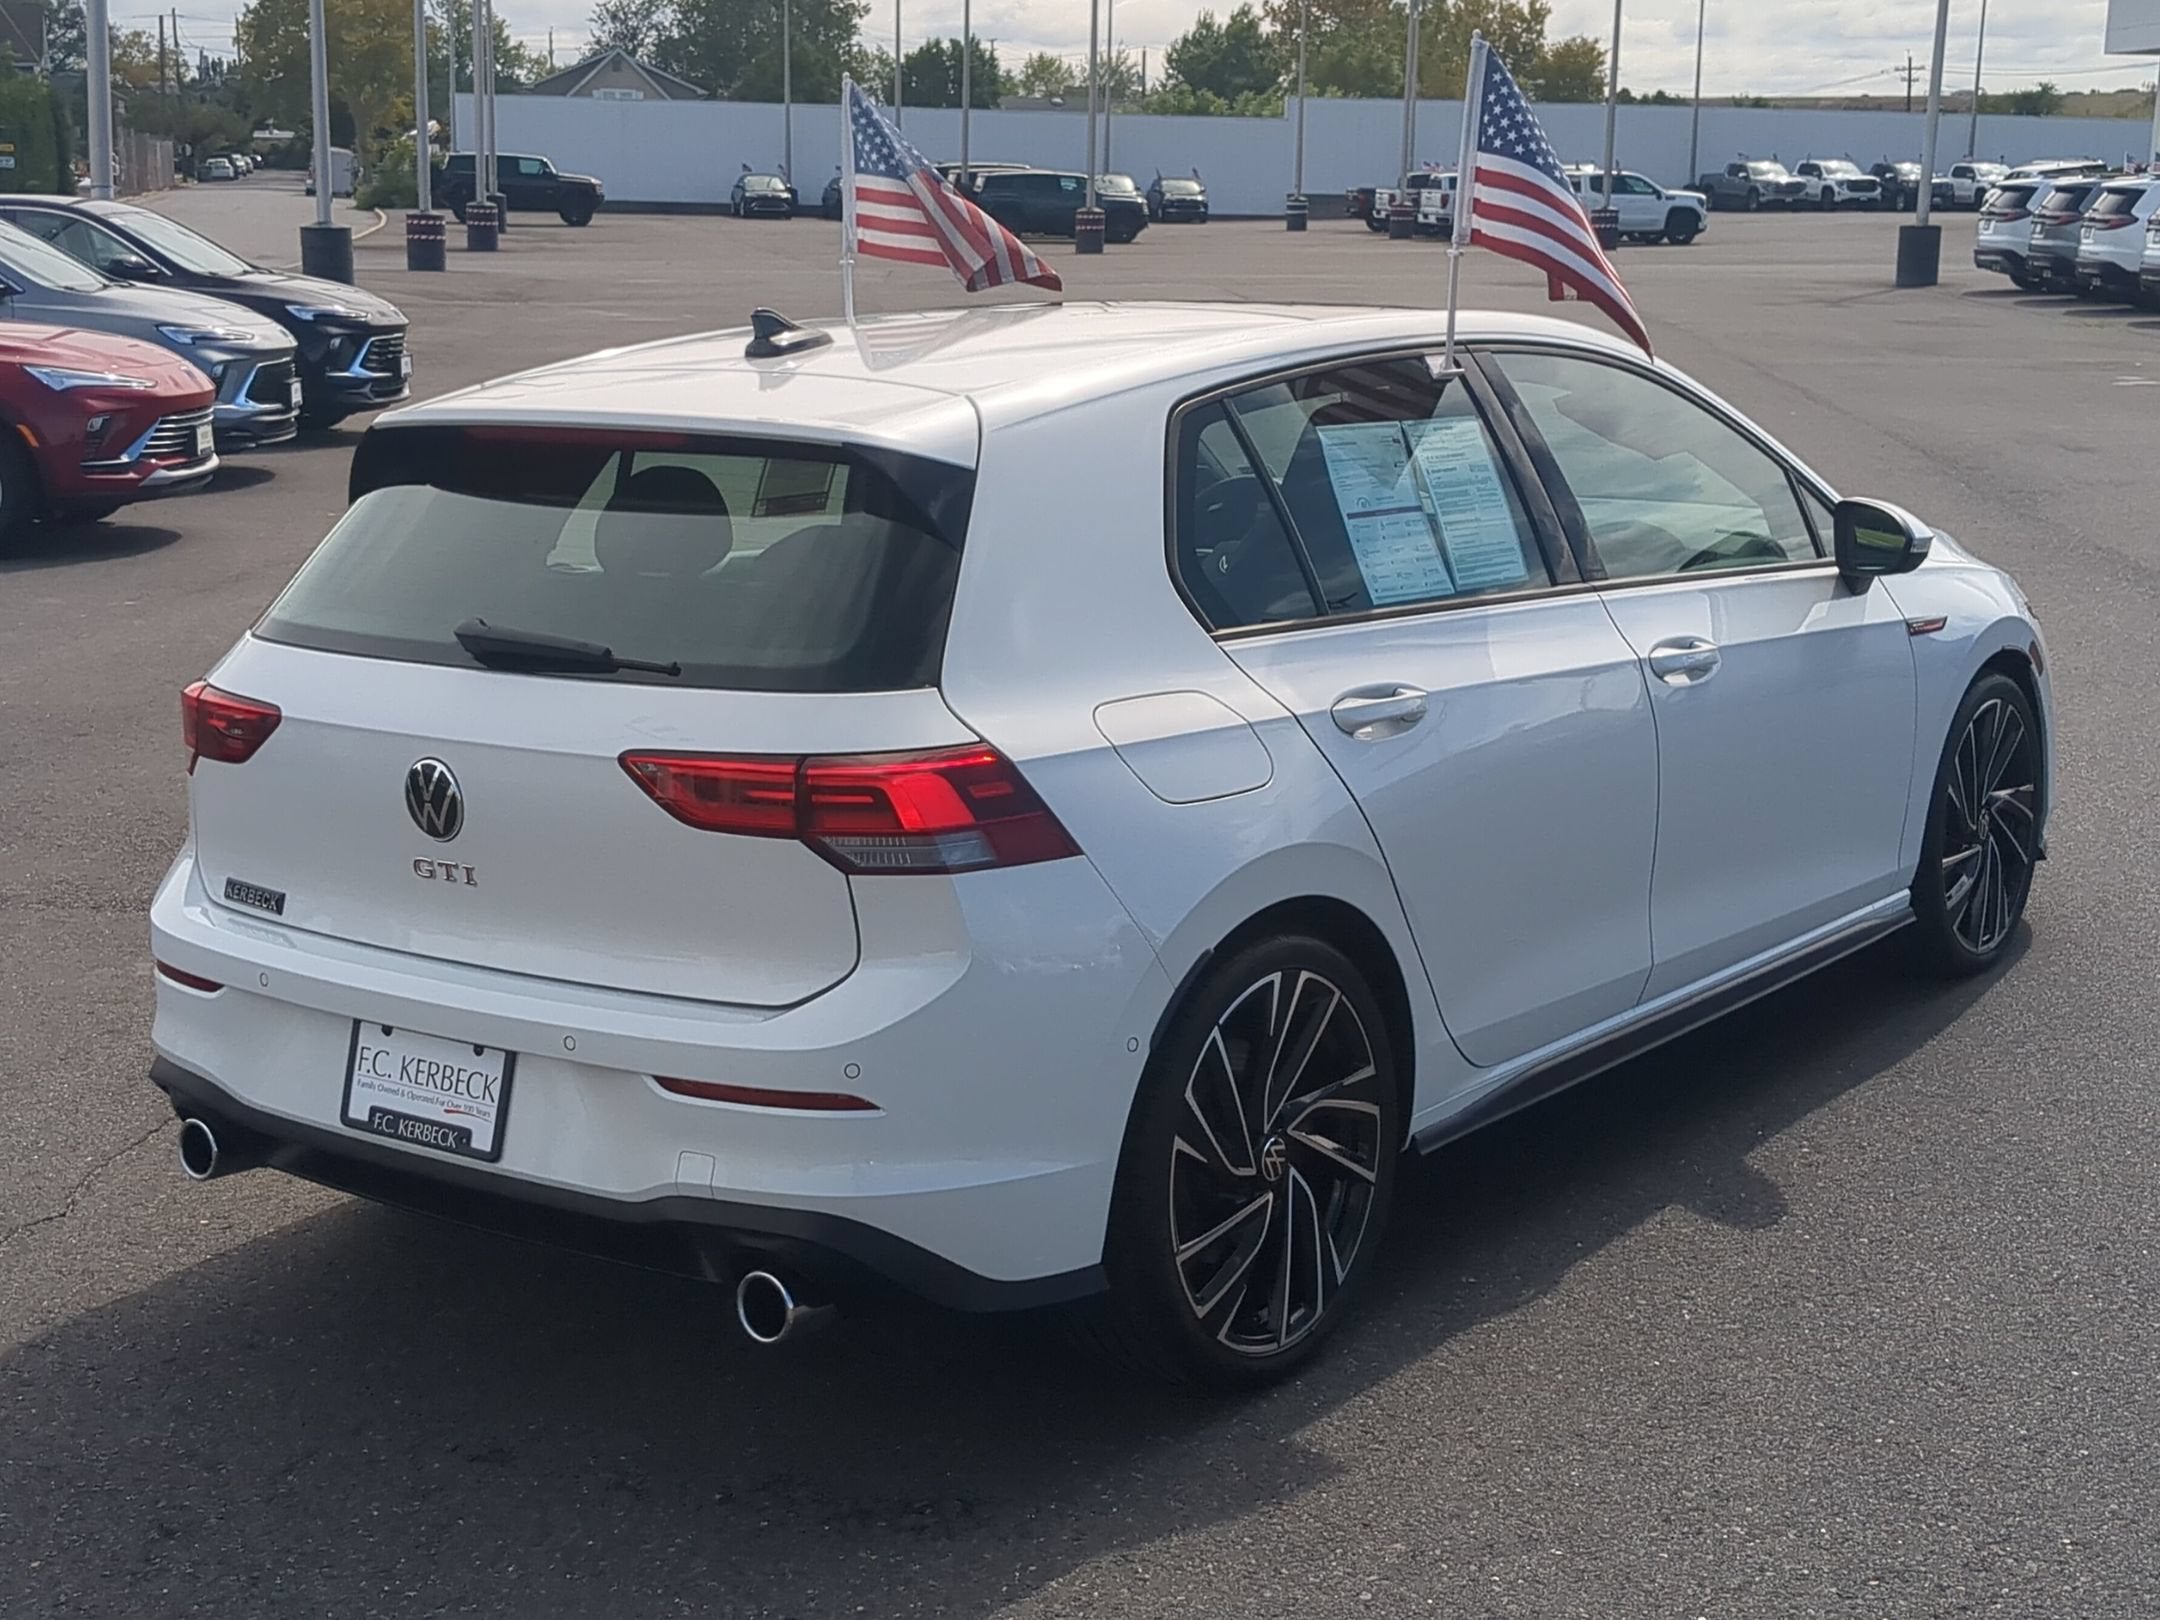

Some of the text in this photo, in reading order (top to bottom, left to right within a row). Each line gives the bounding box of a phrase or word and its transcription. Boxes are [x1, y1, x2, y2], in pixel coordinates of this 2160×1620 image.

[406, 757, 464, 840] VW
[413, 857, 478, 887] GTI
[225, 882, 279, 911] KERBECK
[358, 1046, 498, 1103] F.C. KERBECK
[377, 1083, 400, 1096] Owned
[373, 1112, 458, 1149] F.C. KERBECK
